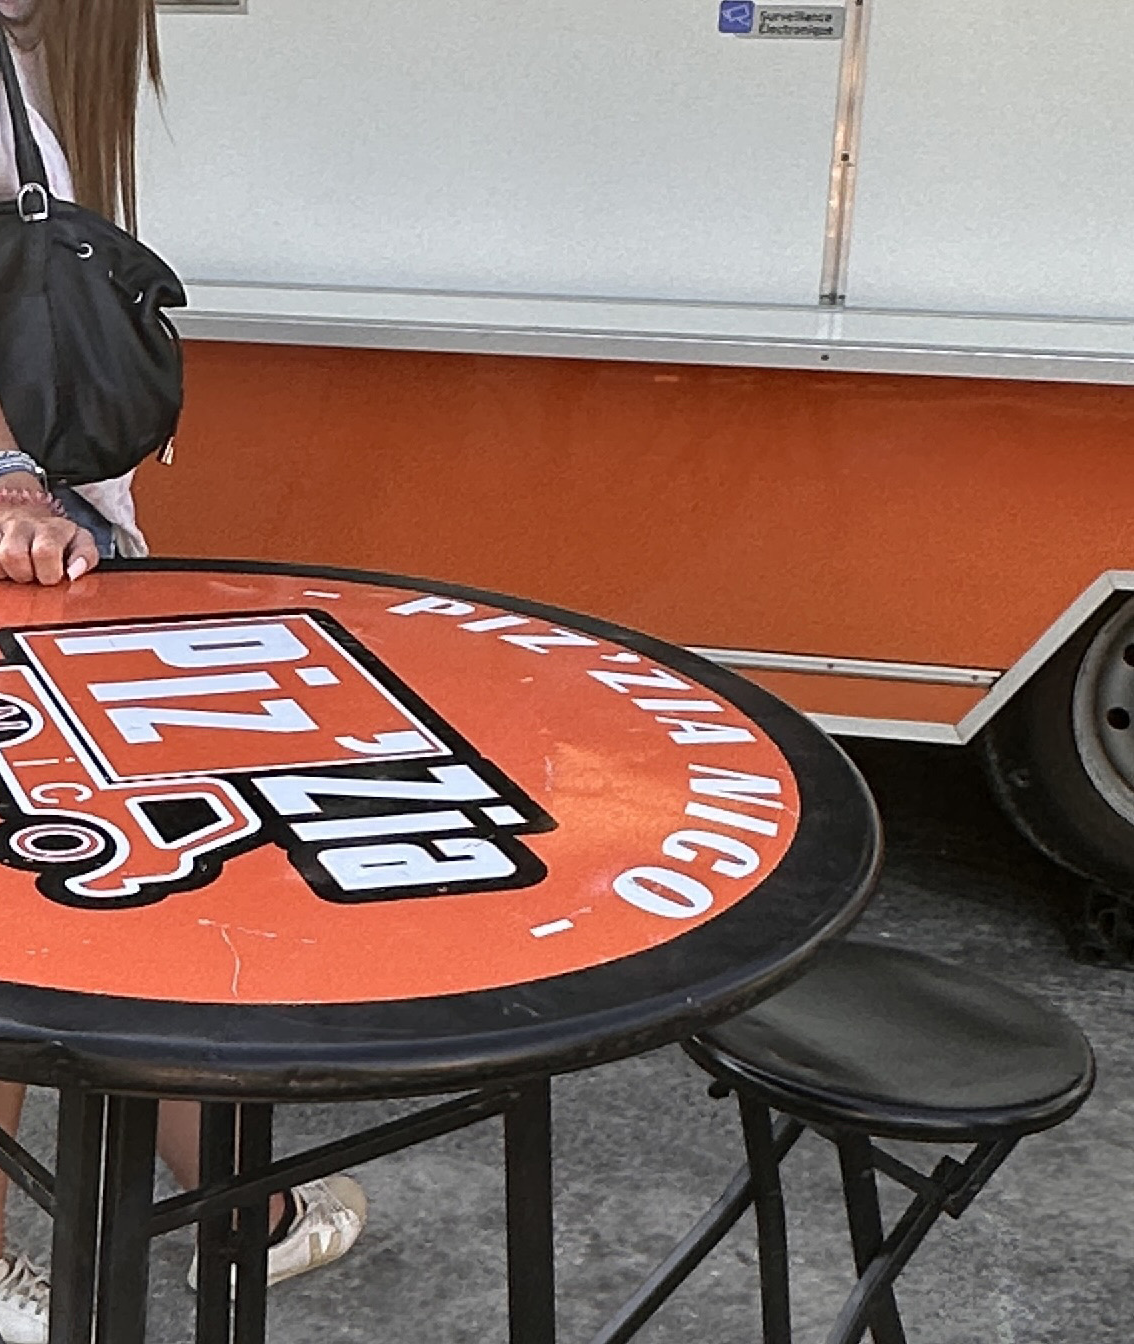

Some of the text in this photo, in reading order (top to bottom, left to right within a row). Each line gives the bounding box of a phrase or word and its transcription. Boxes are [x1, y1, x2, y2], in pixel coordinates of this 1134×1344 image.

[759, 11, 833, 23] Surveillance
[386, 596, 785, 920] PIZ'ZIA NICO
